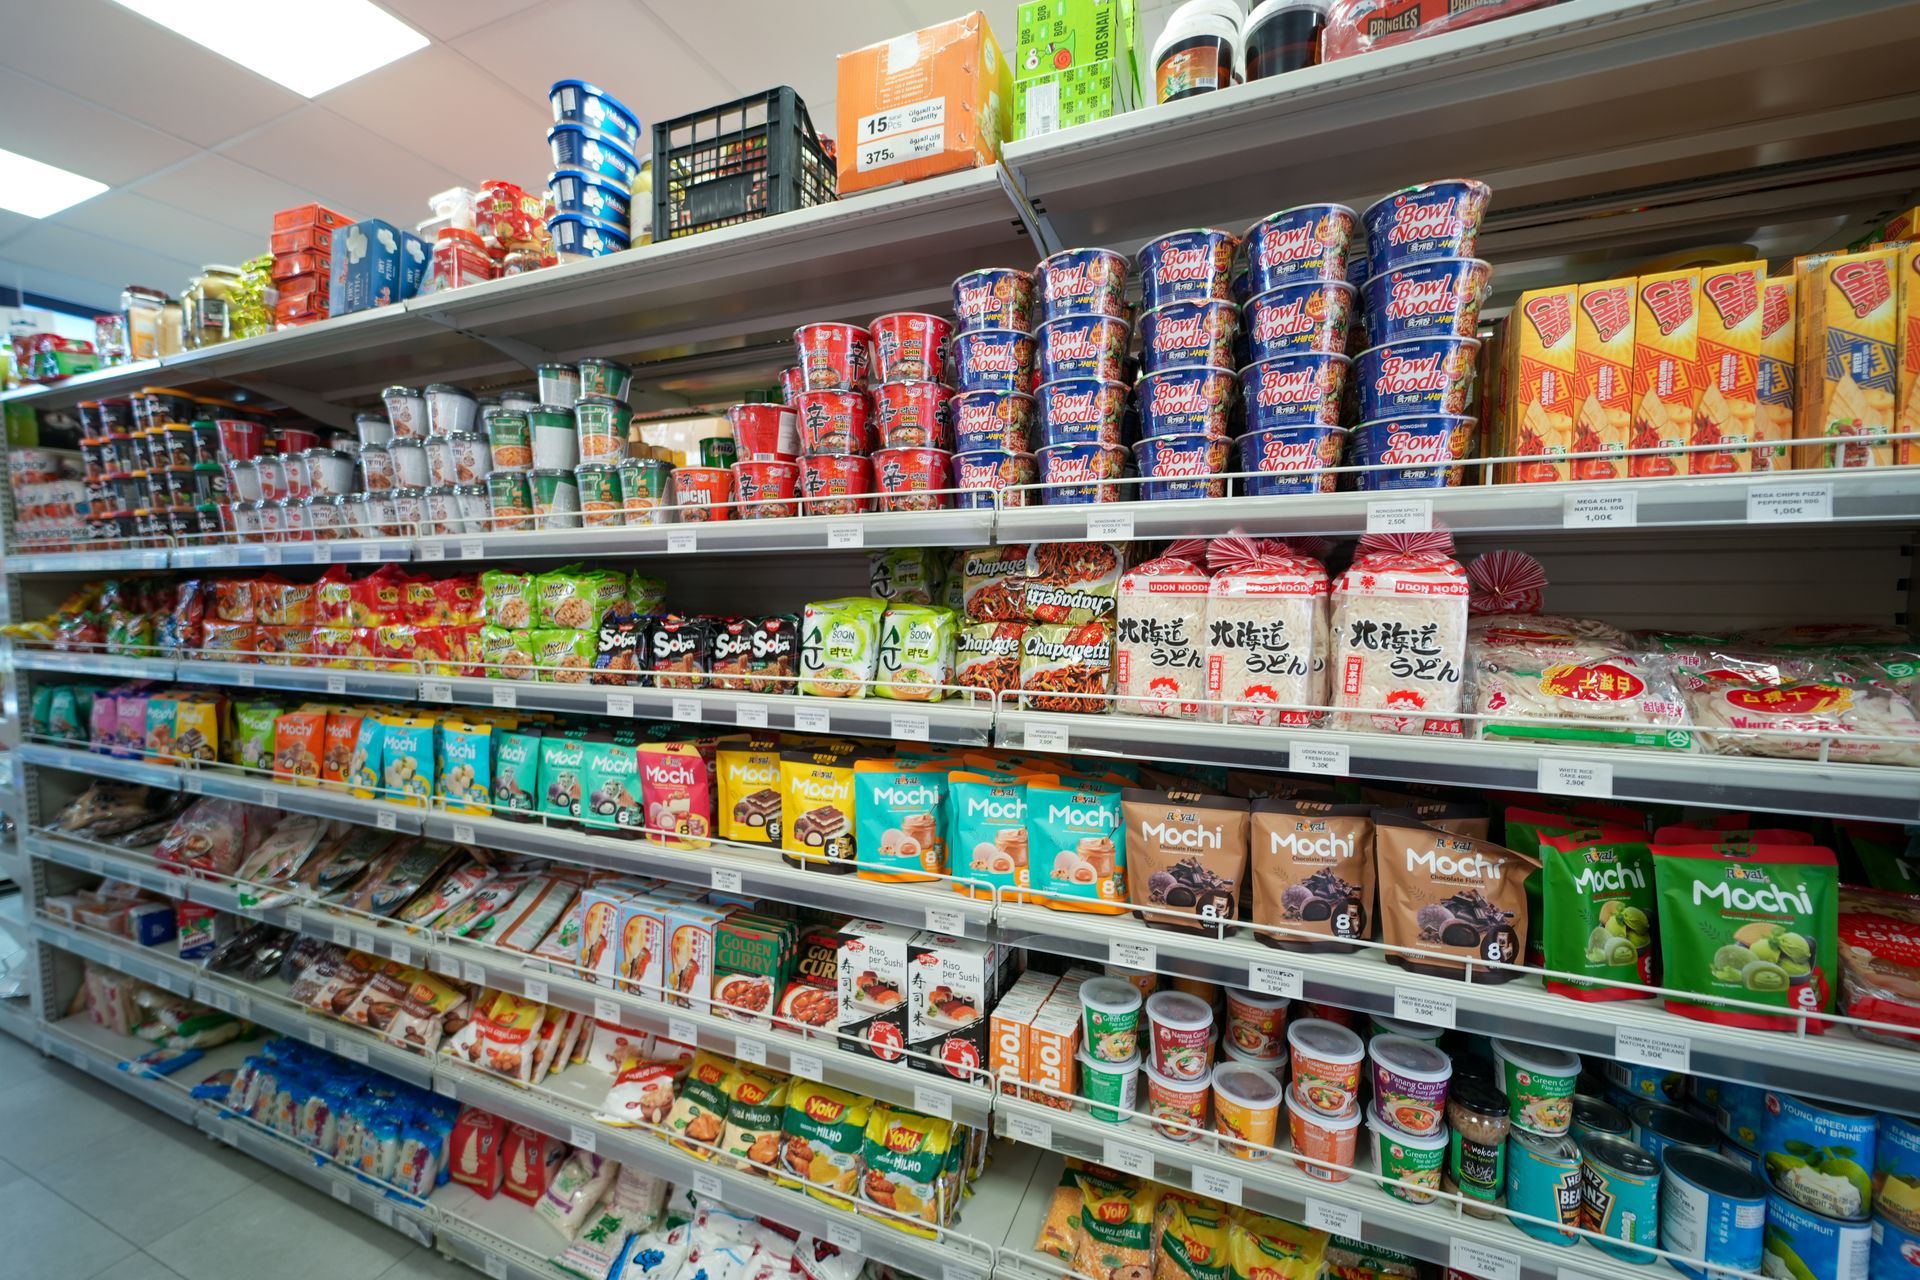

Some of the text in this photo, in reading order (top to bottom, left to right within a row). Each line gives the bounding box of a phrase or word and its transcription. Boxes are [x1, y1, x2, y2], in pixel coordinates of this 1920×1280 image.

[1096, 8, 1110, 40] SNAIL
[1369, 8, 1419, 37] PRINGLES
[867, 116, 887, 135] 15
[911, 113, 938, 123] Quantity
[914, 142, 936, 152] Weight
[1396, 199, 1455, 225] Bowl
[1263, 221, 1312, 251] Bowl
[1388, 218, 1460, 247] Noodle
[1393, 275, 1450, 299] Bowl
[1830, 263, 1876, 319] CHIPS
[1866, 258, 1892, 306] MEGA
[1673, 277, 1693, 328] MEGA
[1703, 273, 1745, 330] CHIPS
[1737, 269, 1758, 319] MEGA
[1257, 297, 1302, 324] Bowl
[1386, 295, 1458, 320] Noodle
[1552, 294, 1572, 334] MEGA
[1581, 289, 1619, 343] CHIPS
[1611, 287, 1632, 332] MEGA
[1641, 281, 1681, 335] CHIPS
[1770, 284, 1790, 329] MEGA
[1157, 313, 1206, 334] Bowl
[1255, 315, 1313, 341] Noodle
[1524, 297, 1560, 348] CHIPS
[1153, 329, 1211, 352] Noodle
[1381, 353, 1442, 377] Bowl
[1262, 367, 1312, 389] Bowl
[1376, 372, 1448, 395] Noodle
[1051, 390, 1092, 409] Bowl
[1154, 381, 1200, 400] Bowl
[1258, 384, 1321, 407] Noodle
[959, 402, 995, 420] Bowl
[1049, 405, 1100, 424] Noodle
[1151, 396, 1208, 416] Noodle
[957, 417, 1004, 435] Noodle
[1264, 439, 1315, 459] Bowl
[1387, 430, 1446, 450] Bowl
[1049, 455, 1088, 473] Bowl
[1157, 446, 1202, 465] Bowl
[1258, 457, 1322, 471] Noodle
[1381, 450, 1452, 464] Noodle
[962, 462, 998, 479] Bowl
[1153, 462, 1210, 477] Noodle
[1150, 583, 1177, 593] UDON
[1397, 583, 1430, 594] UDON
[601, 629, 637, 651] Soba
[753, 631, 791, 654] Soba
[832, 630, 855, 640] SOON
[910, 630, 932, 640] SOON
[1118, 618, 1189, 648] 北海道
[1209, 619, 1291, 650] 北海道
[1351, 619, 1442, 655] 北海道
[653, 631, 695, 657] Soba
[1023, 637, 1110, 662] Chapagetti
[1246, 653, 1307, 675] うどん
[1390, 657, 1461, 683] うどん
[279, 722, 313, 737] Mochi
[383, 735, 418, 752] Mochi
[591, 754, 638, 774] Mochi
[646, 765, 696, 785] Mochi
[791, 777, 849, 799] Mochi
[874, 785, 940, 805] Mochi
[968, 797, 1027, 818] Moch
[1048, 804, 1120, 828] Mochi
[1142, 820, 1223, 849] Mochi
[1271, 831, 1355, 858] Mochi
[1292, 855, 1320, 863] Chocolate
[1406, 848, 1502, 881] Mochi
[1430, 874, 1464, 884] Chocolate
[1575, 861, 1646, 894] Mochi
[1692, 879, 1814, 915] Mochi
[1336, 914, 1350, 929] 8
[721, 934, 772, 956] GOLDEN
[808, 945, 838, 960] GOL
[868, 945, 885, 957] Riso
[1487, 942, 1501, 960] 8
[718, 950, 772, 973] CURRY
[800, 959, 838, 979] CUR
[869, 956, 904, 969] per Sushi
[942, 959, 960, 971] Riso
[943, 970, 980, 983] per Sushi
[1797, 987, 1818, 1007] 8
[1102, 1014, 1121, 1022] Green
[1171, 1031, 1193, 1040] Namya
[1000, 1023, 1021, 1081] TOFU
[1640, 1049, 1663, 1059] 3,90€
[1040, 1035, 1061, 1092] TOFU
[1391, 1073, 1436, 1091] Panang Curry
[1532, 1075, 1558, 1086] Green
[809, 1097, 845, 1120] Yoki
[1783, 1102, 1848, 1131] YOUNG GREEN
[816, 1126, 842, 1143] MILHO
[889, 1128, 917, 1150] Yoki
[1814, 1125, 1862, 1142] IN BRINE
[893, 1156, 921, 1173] MILHO
[1405, 1150, 1428, 1159] Green
[1103, 1205, 1128, 1220] Yoki
[1785, 1208, 1835, 1237] JACKFRUIT
